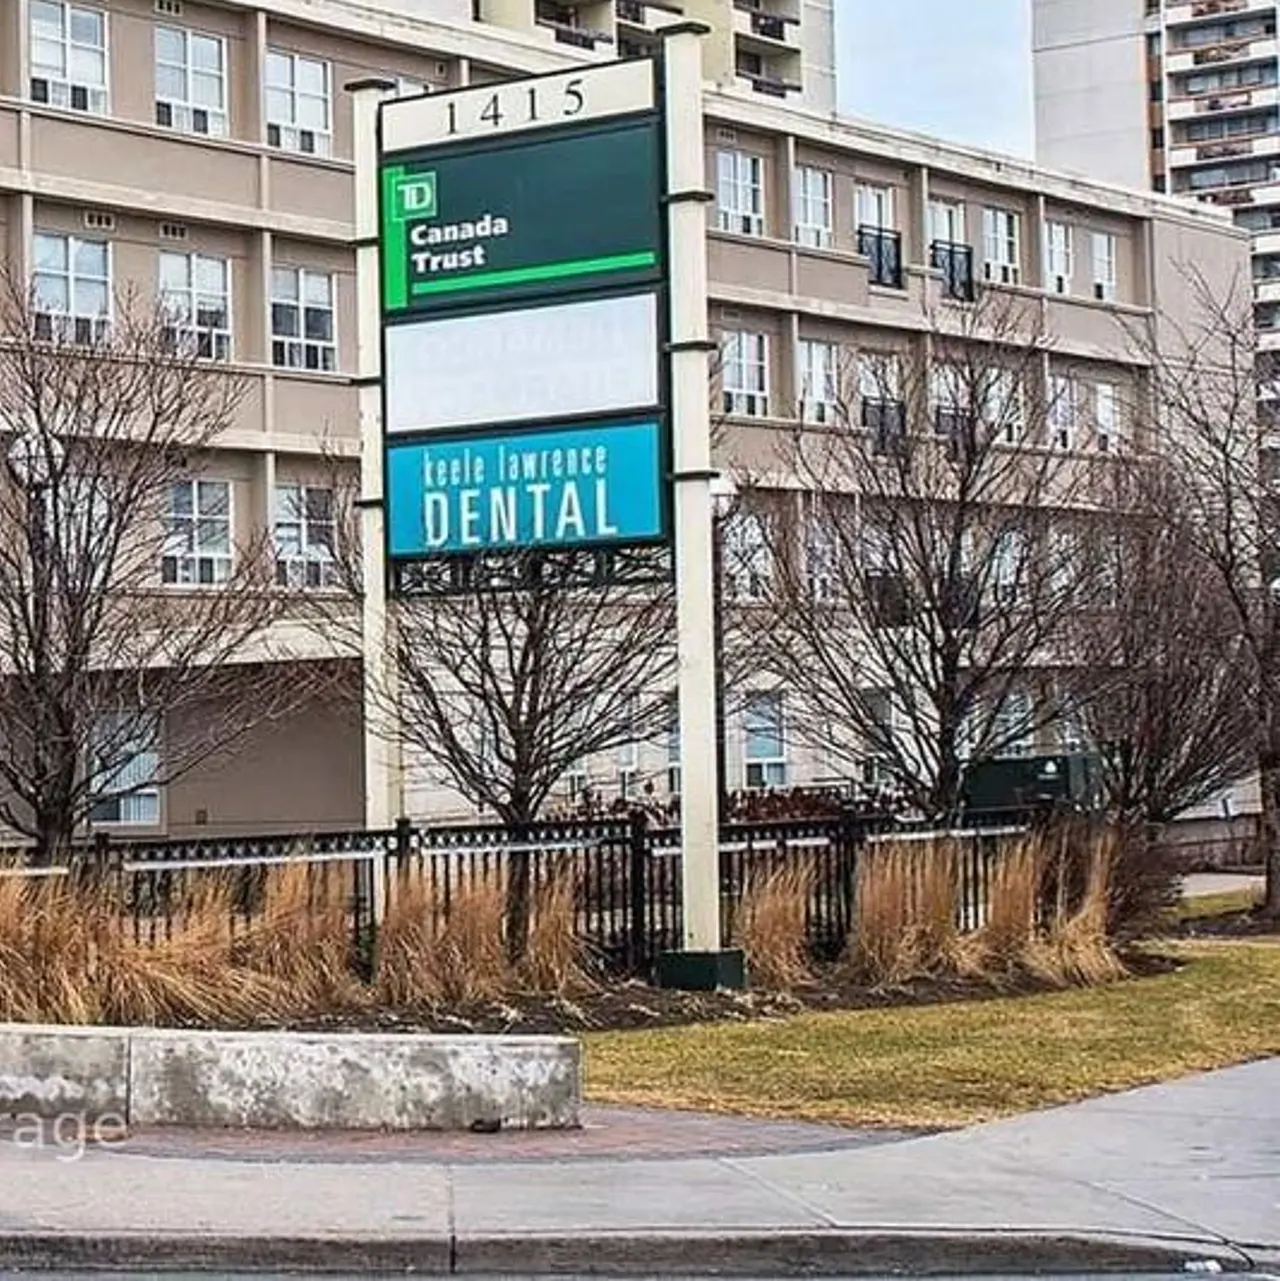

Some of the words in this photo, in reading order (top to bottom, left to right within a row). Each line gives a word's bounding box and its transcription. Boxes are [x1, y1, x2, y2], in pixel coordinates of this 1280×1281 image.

[446, 78, 584, 135] 1415
[397, 182, 433, 211] TD
[410, 214, 509, 246] Canada
[410, 244, 486, 274] Trust
[424, 447, 485, 488] keele
[497, 444, 608, 482] lawrence
[424, 477, 618, 548] DENTAL
